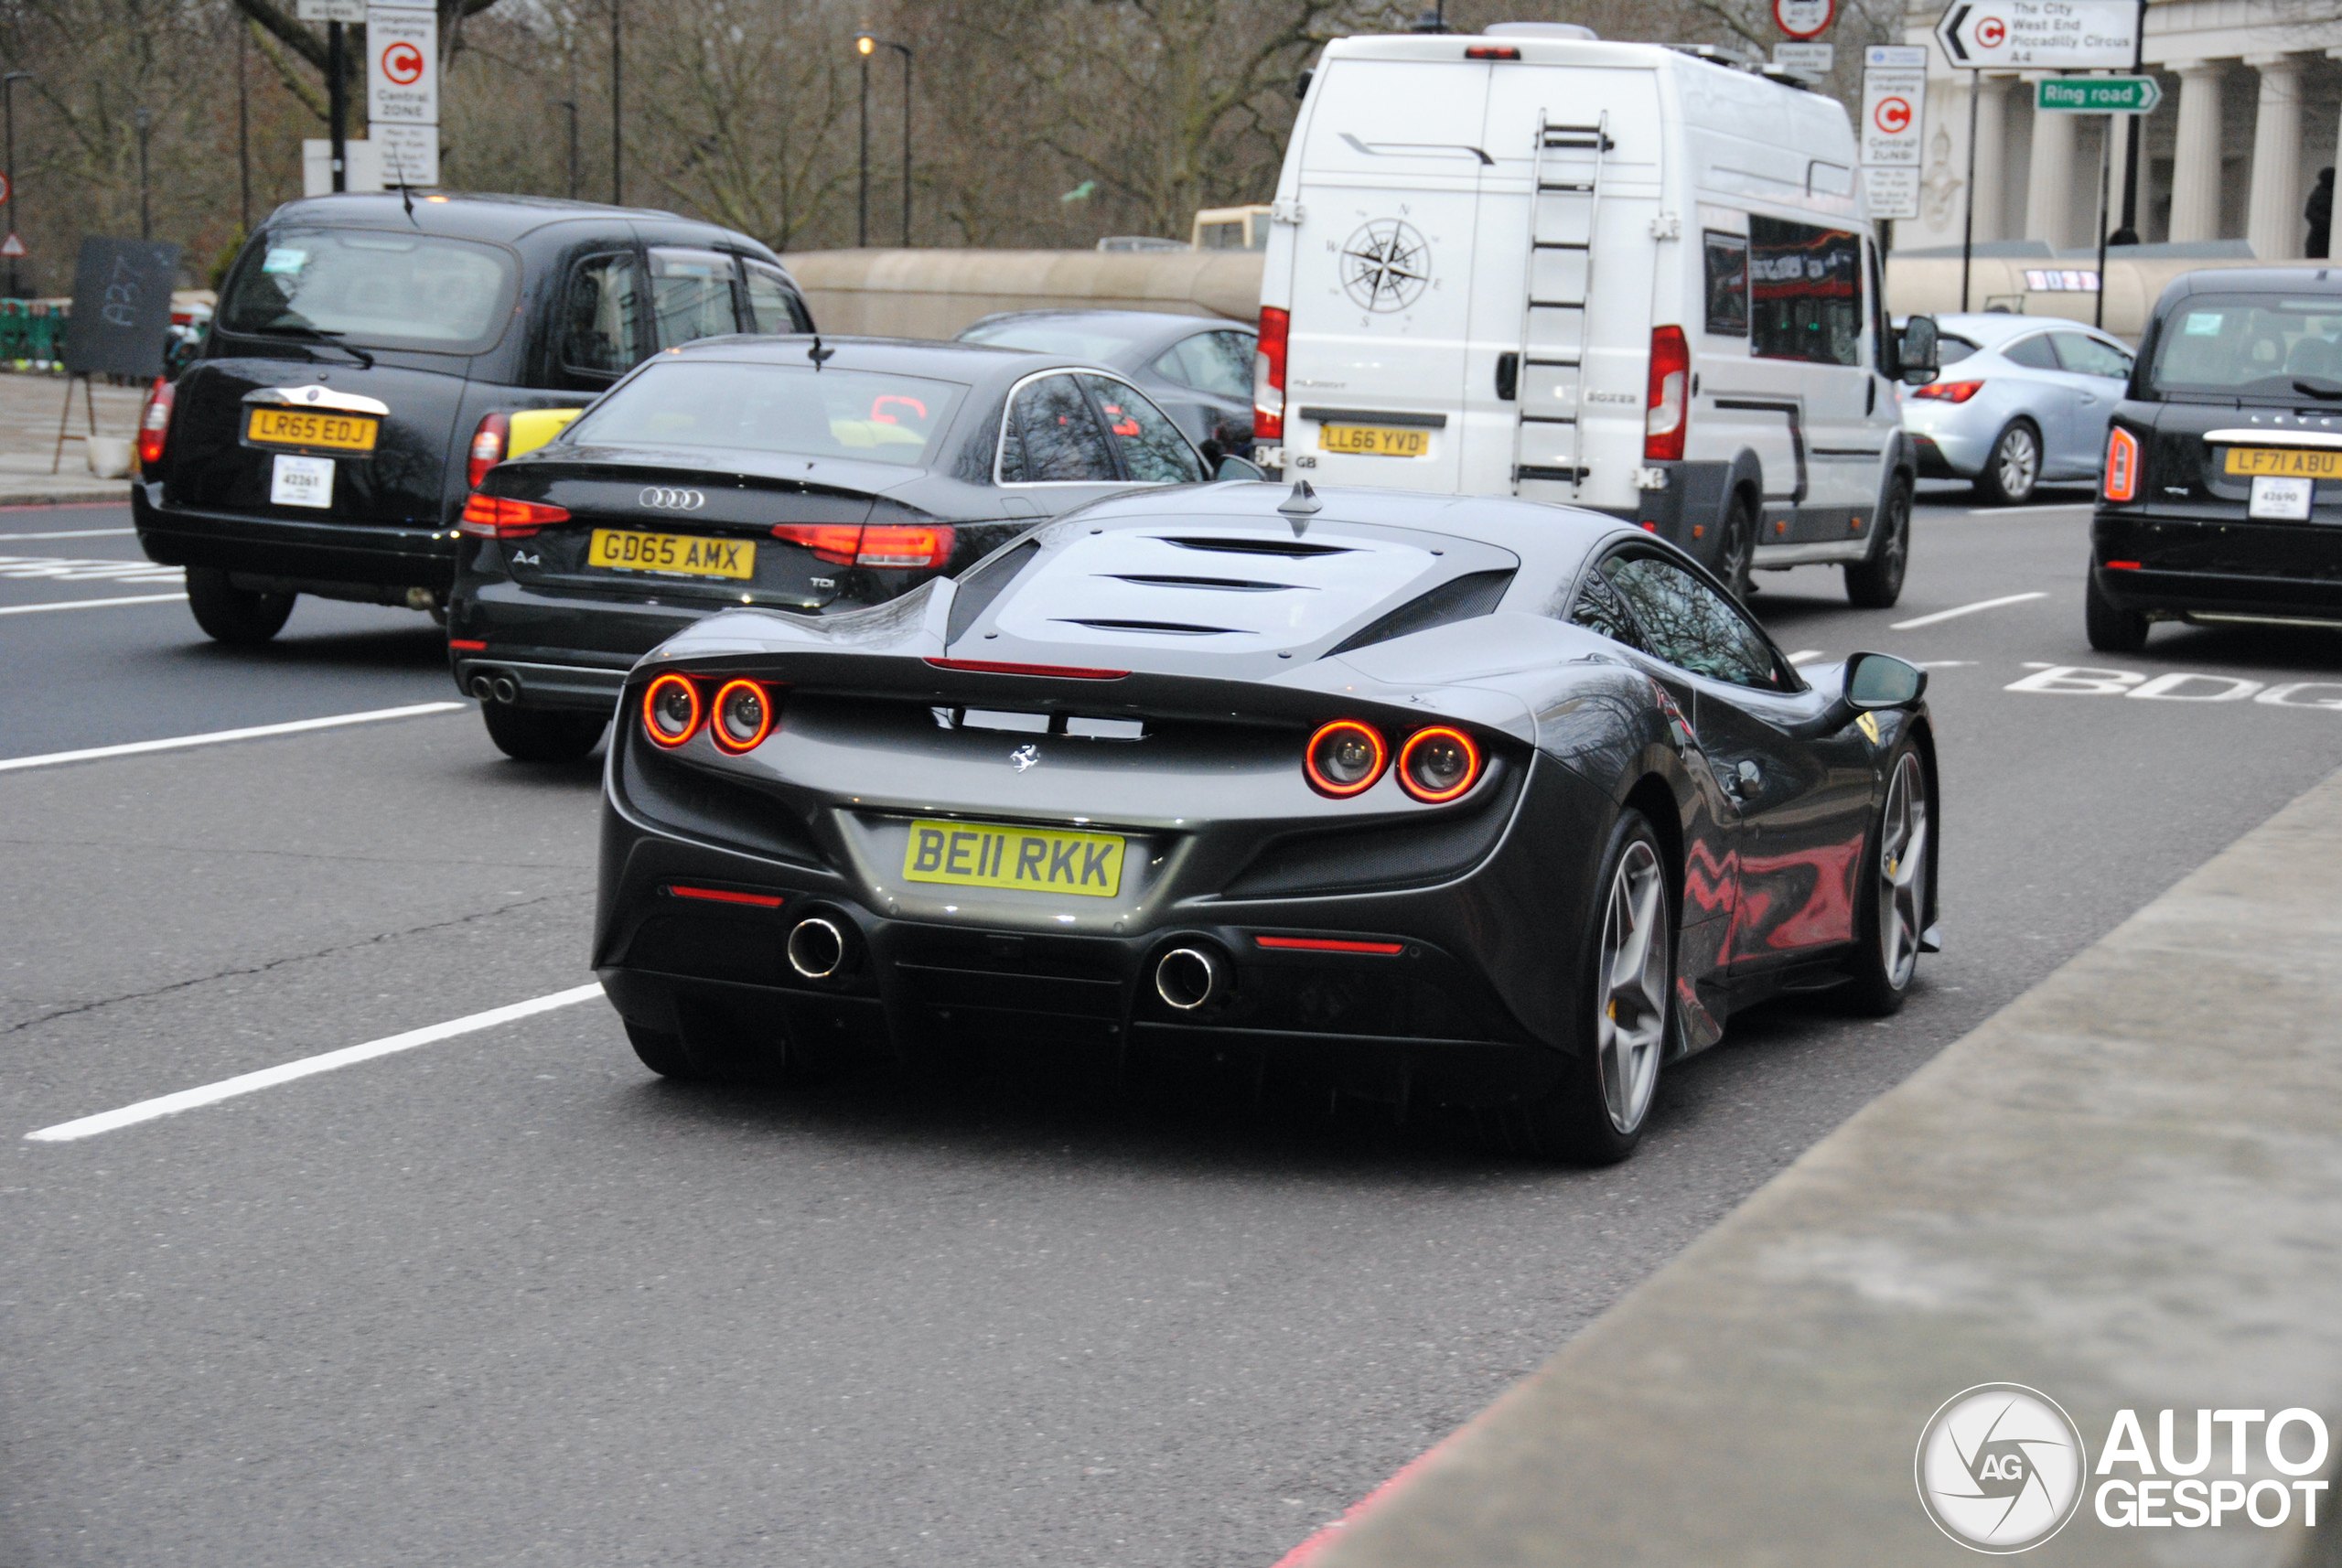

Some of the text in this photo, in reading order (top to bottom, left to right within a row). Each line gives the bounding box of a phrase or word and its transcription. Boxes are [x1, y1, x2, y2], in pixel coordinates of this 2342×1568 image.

[2014, 3, 2071, 16] The City
[2012, 19, 2080, 31] West End
[2012, 34, 2131, 48] Piccadilly Circus
[2045, 84, 2133, 105] Ring road
[382, 104, 422, 116] ZONE
[261, 414, 366, 443] LR65 EDJ
[1327, 430, 1421, 451] LL66 YVD
[1295, 456, 1317, 468] GB
[2238, 451, 2335, 473] LF71 ABU
[512, 550, 540, 565] A4
[604, 533, 741, 571] GD65 AMX
[1015, 837, 1114, 887] RKK
